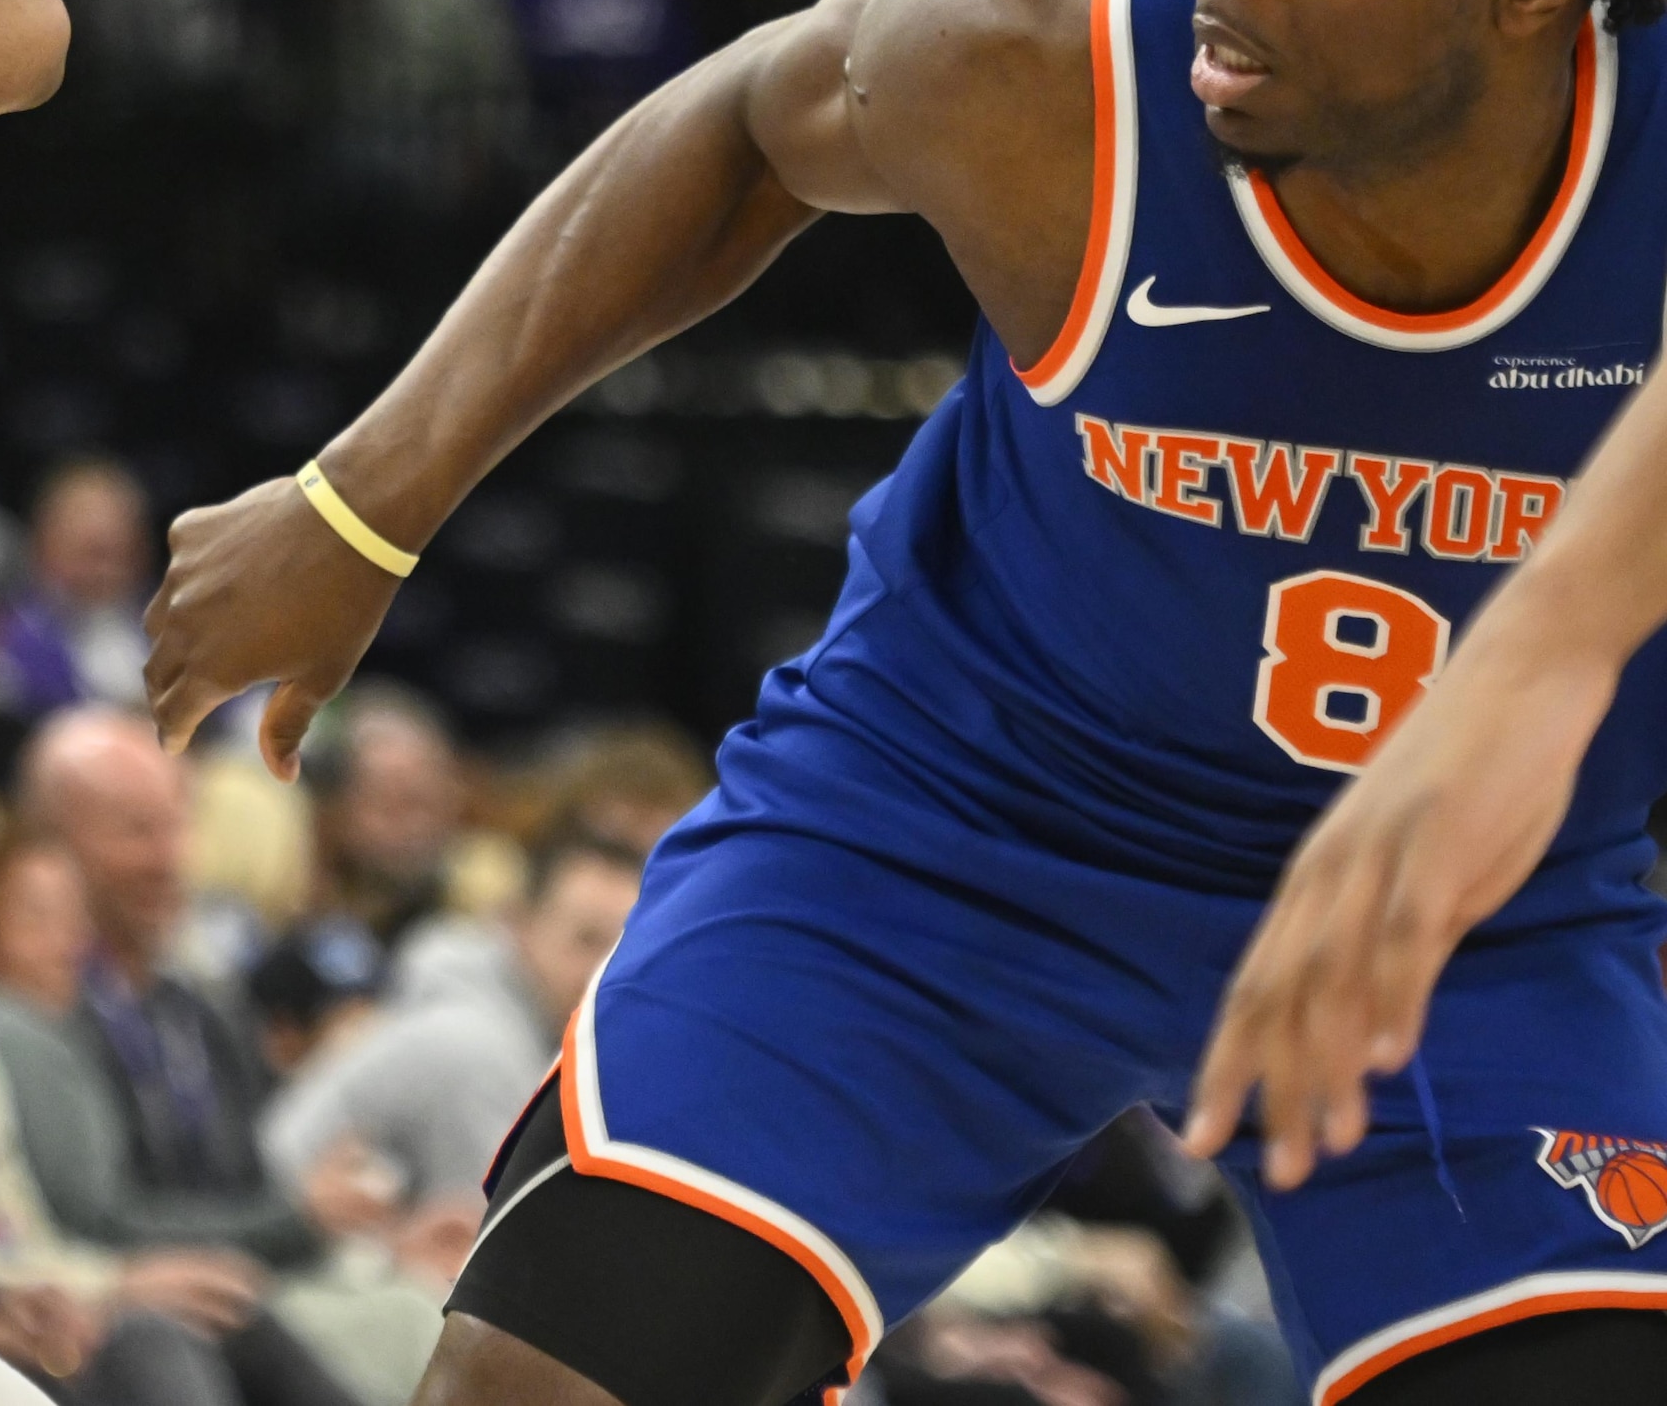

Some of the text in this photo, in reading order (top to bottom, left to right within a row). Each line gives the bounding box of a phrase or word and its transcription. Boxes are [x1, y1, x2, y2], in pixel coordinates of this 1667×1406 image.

[1489, 363, 1645, 389] abu dhabi
[1494, 355, 1577, 367] experience
[1074, 411, 1572, 563] NEW YOR
[1252, 569, 1452, 778] 8
